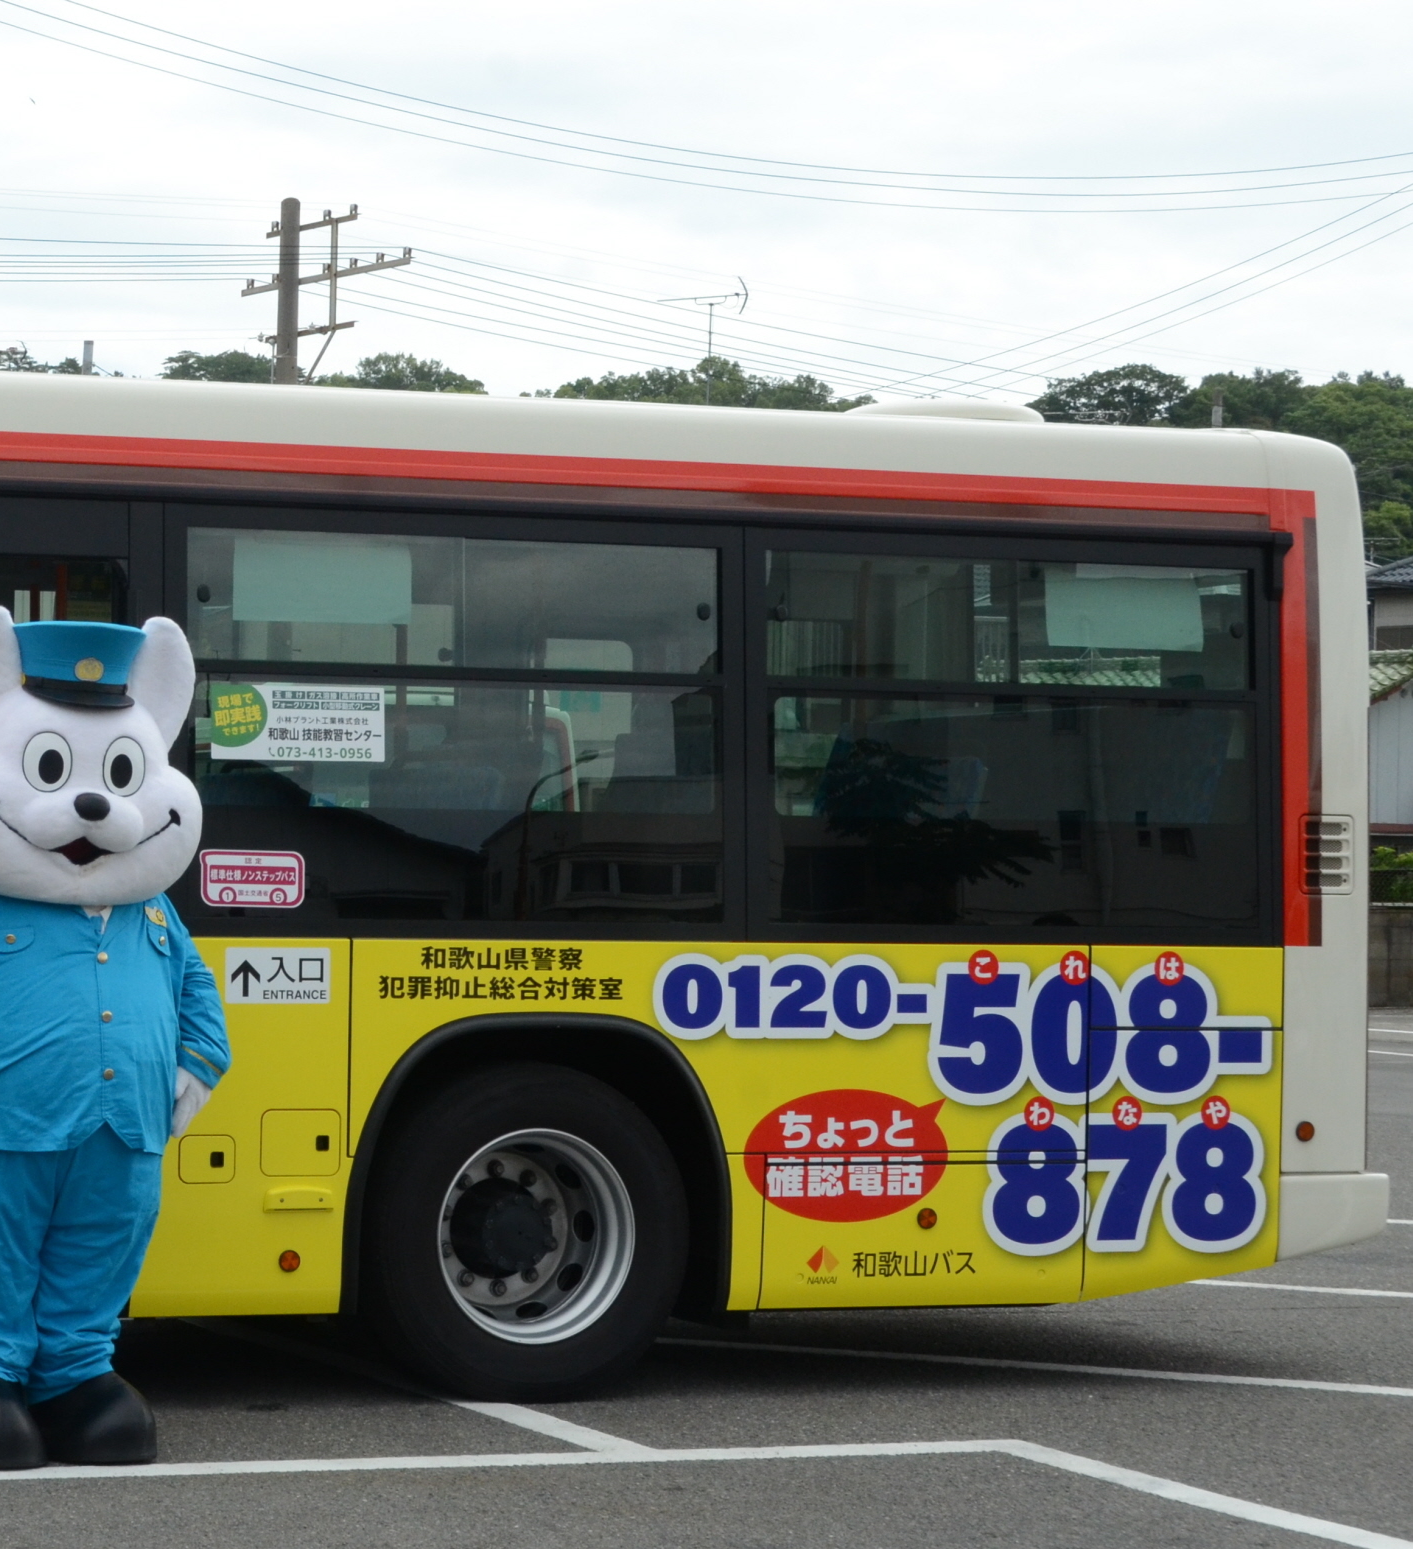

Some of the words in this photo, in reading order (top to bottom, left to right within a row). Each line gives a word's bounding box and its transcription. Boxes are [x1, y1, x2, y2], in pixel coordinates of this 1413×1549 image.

[217, 692, 254, 708] 現場で
[274, 701, 319, 709] フォークリフト
[214, 705, 262, 727] 即実践
[276, 716, 369, 726] 小林プラント工業株式会社
[268, 727, 300, 741] 和歌山
[302, 728, 382, 742] 技能教習センター
[277, 747, 372, 759] 073-413-0956
[210, 868, 296, 882] 標準仕様ノンステップバス
[275, 893, 282, 902] 5
[421, 946, 583, 971] 和歌山県警察
[974, 956, 993, 978] こ
[1064, 955, 1087, 980] れ
[1158, 957, 1180, 980] は
[267, 957, 324, 983] 入口
[262, 989, 327, 1000] ENTRANCE
[379, 975, 624, 1000] 犯罪抑止総合対策室
[1029, 1101, 1051, 1126] わ
[1117, 1101, 1138, 1126] な
[1205, 1101, 1227, 1125] や
[779, 1110, 915, 1149] ちょっと
[766, 1155, 924, 1198] 確認電話
[984, 1109, 1265, 1255] 878
[852, 1249, 977, 1278] 和歌山バス
[806, 1276, 838, 1285] NANKAI
